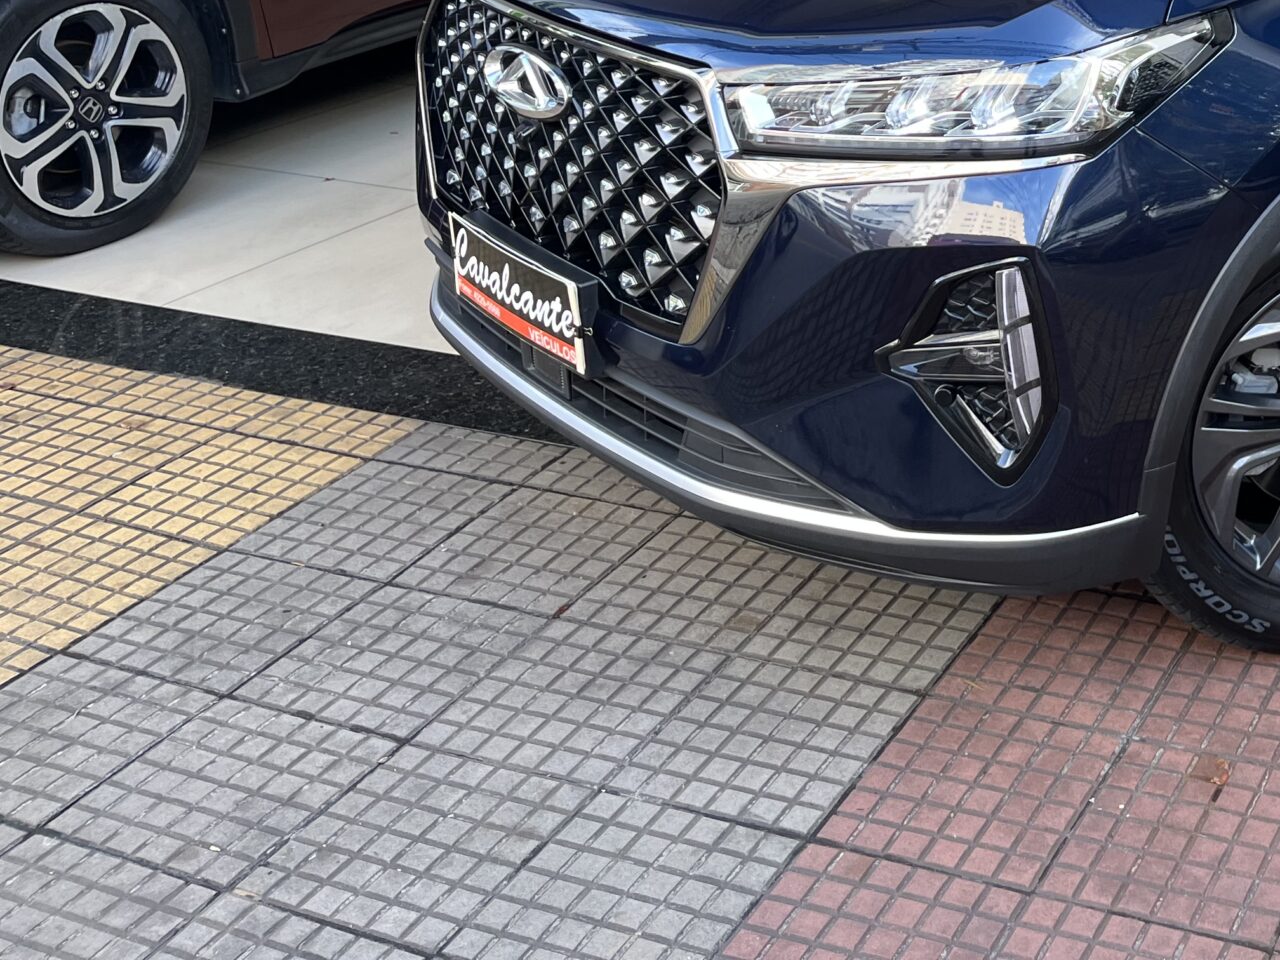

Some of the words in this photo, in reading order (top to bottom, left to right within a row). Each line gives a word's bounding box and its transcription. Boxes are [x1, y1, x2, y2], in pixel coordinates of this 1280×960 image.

[455, 227, 575, 338] Cavalcante
[528, 327, 577, 364] VEÍCULOS
[1164, 525, 1272, 634] SCORPIO
